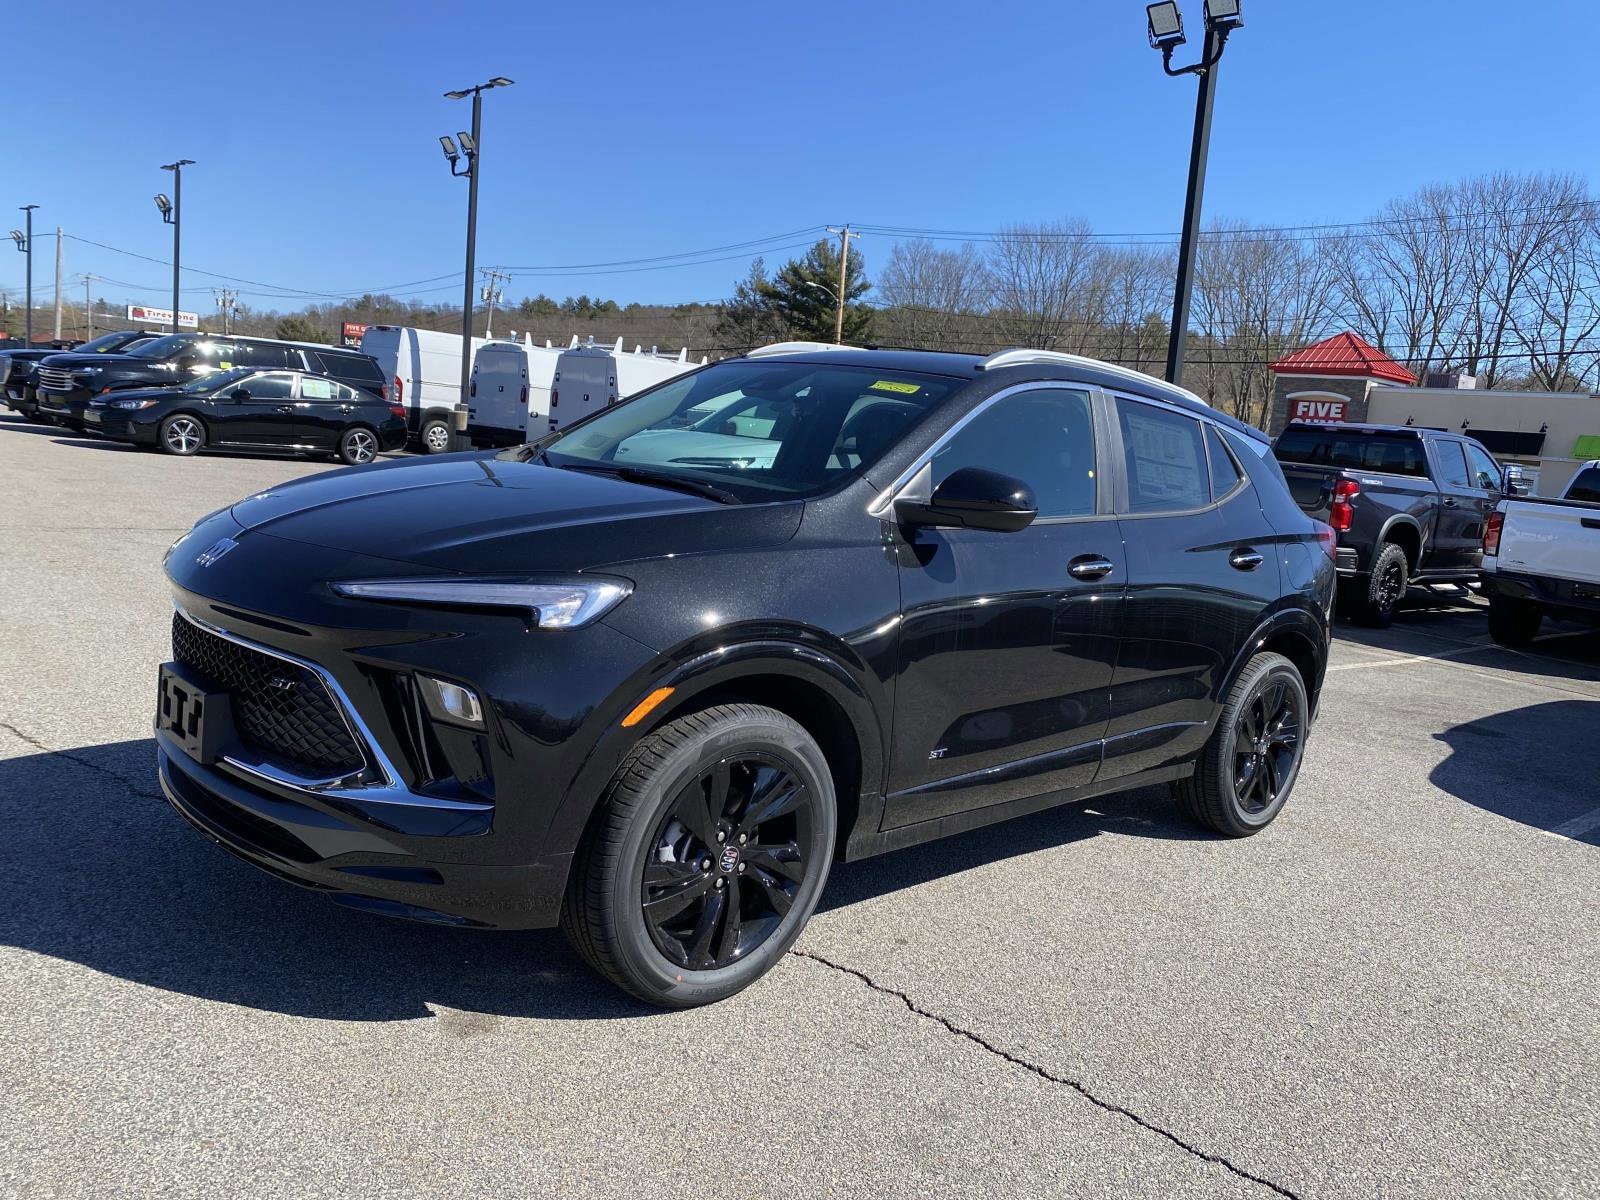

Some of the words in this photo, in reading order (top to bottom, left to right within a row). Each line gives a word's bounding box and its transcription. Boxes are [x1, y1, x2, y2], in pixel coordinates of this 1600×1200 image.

[147, 310, 194, 321] Firesone
[1296, 401, 1343, 418] FIVE
[928, 748, 949, 760] ST
